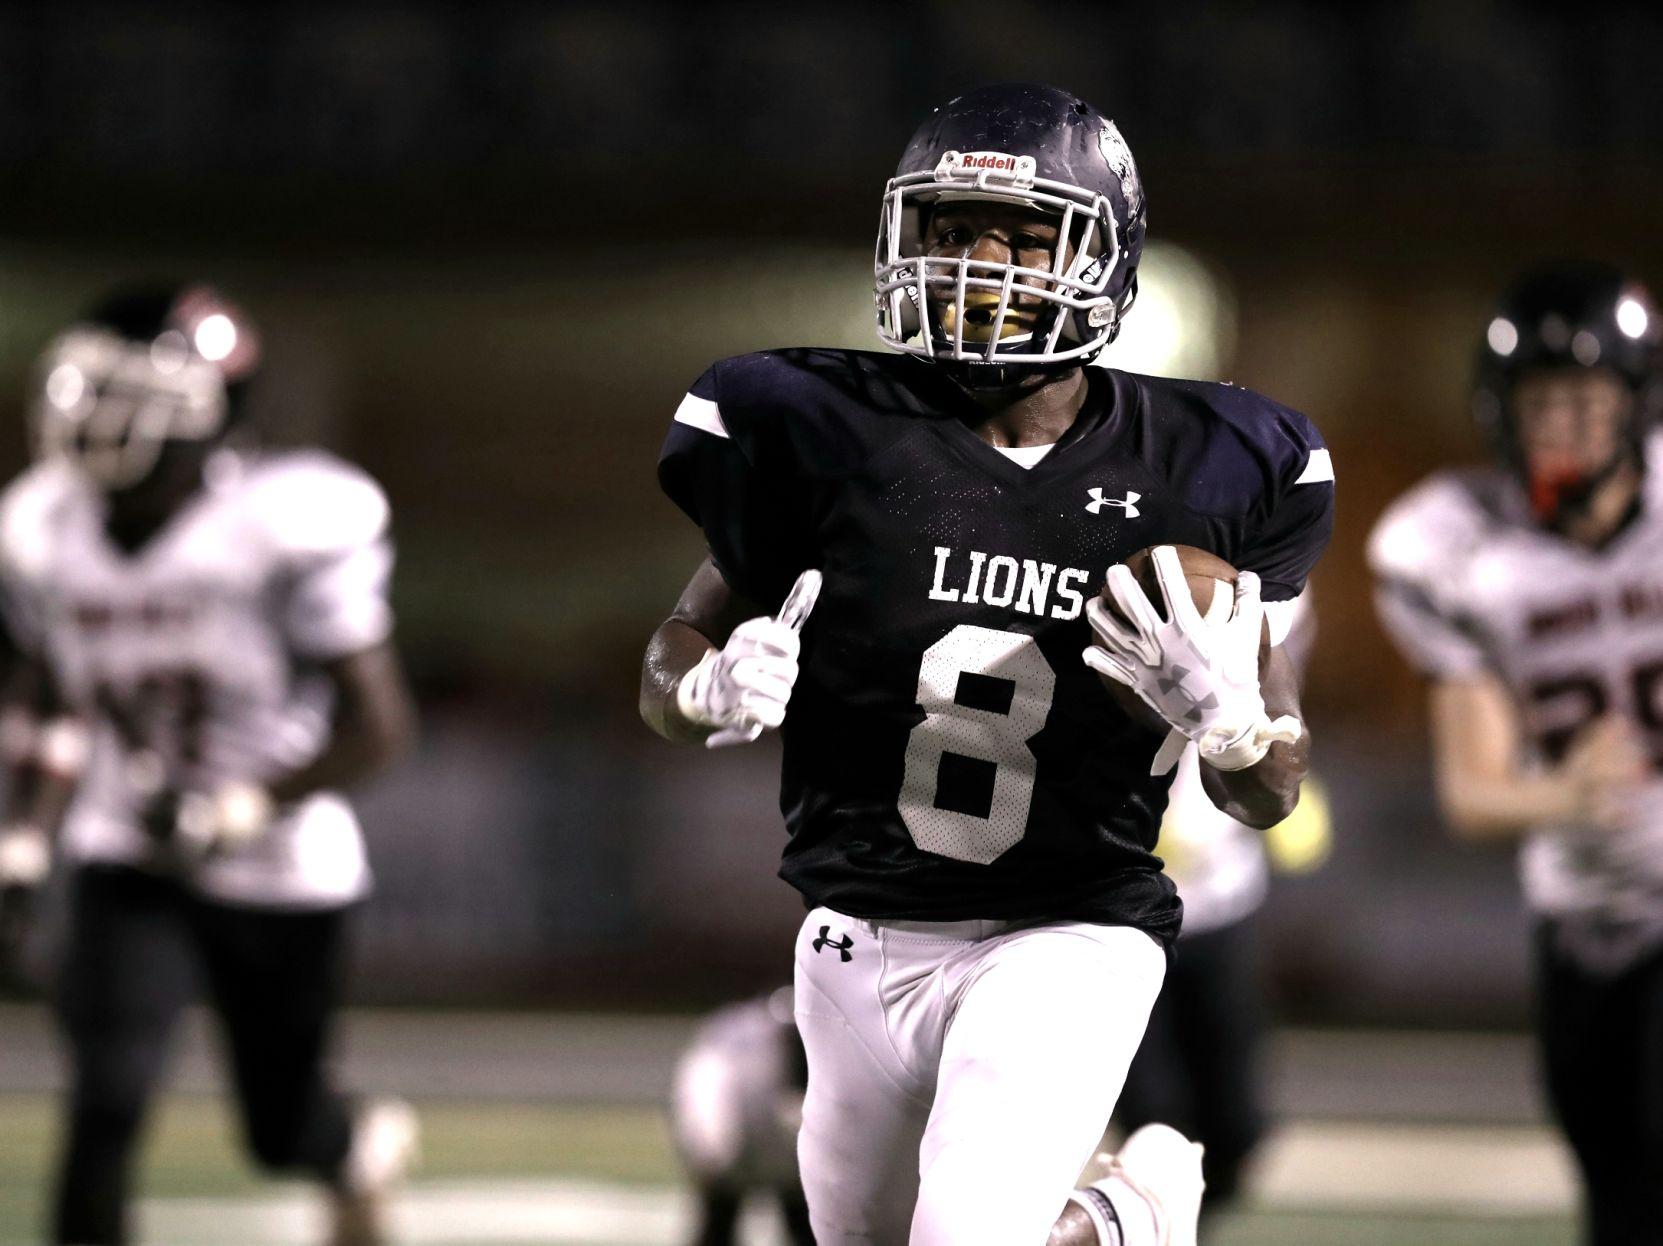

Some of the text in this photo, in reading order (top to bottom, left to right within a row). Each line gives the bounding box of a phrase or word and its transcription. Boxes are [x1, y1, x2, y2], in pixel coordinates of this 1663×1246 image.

[962, 154, 1016, 171] Riddell
[928, 546, 1089, 620] LIONS
[897, 624, 1056, 865] 8
